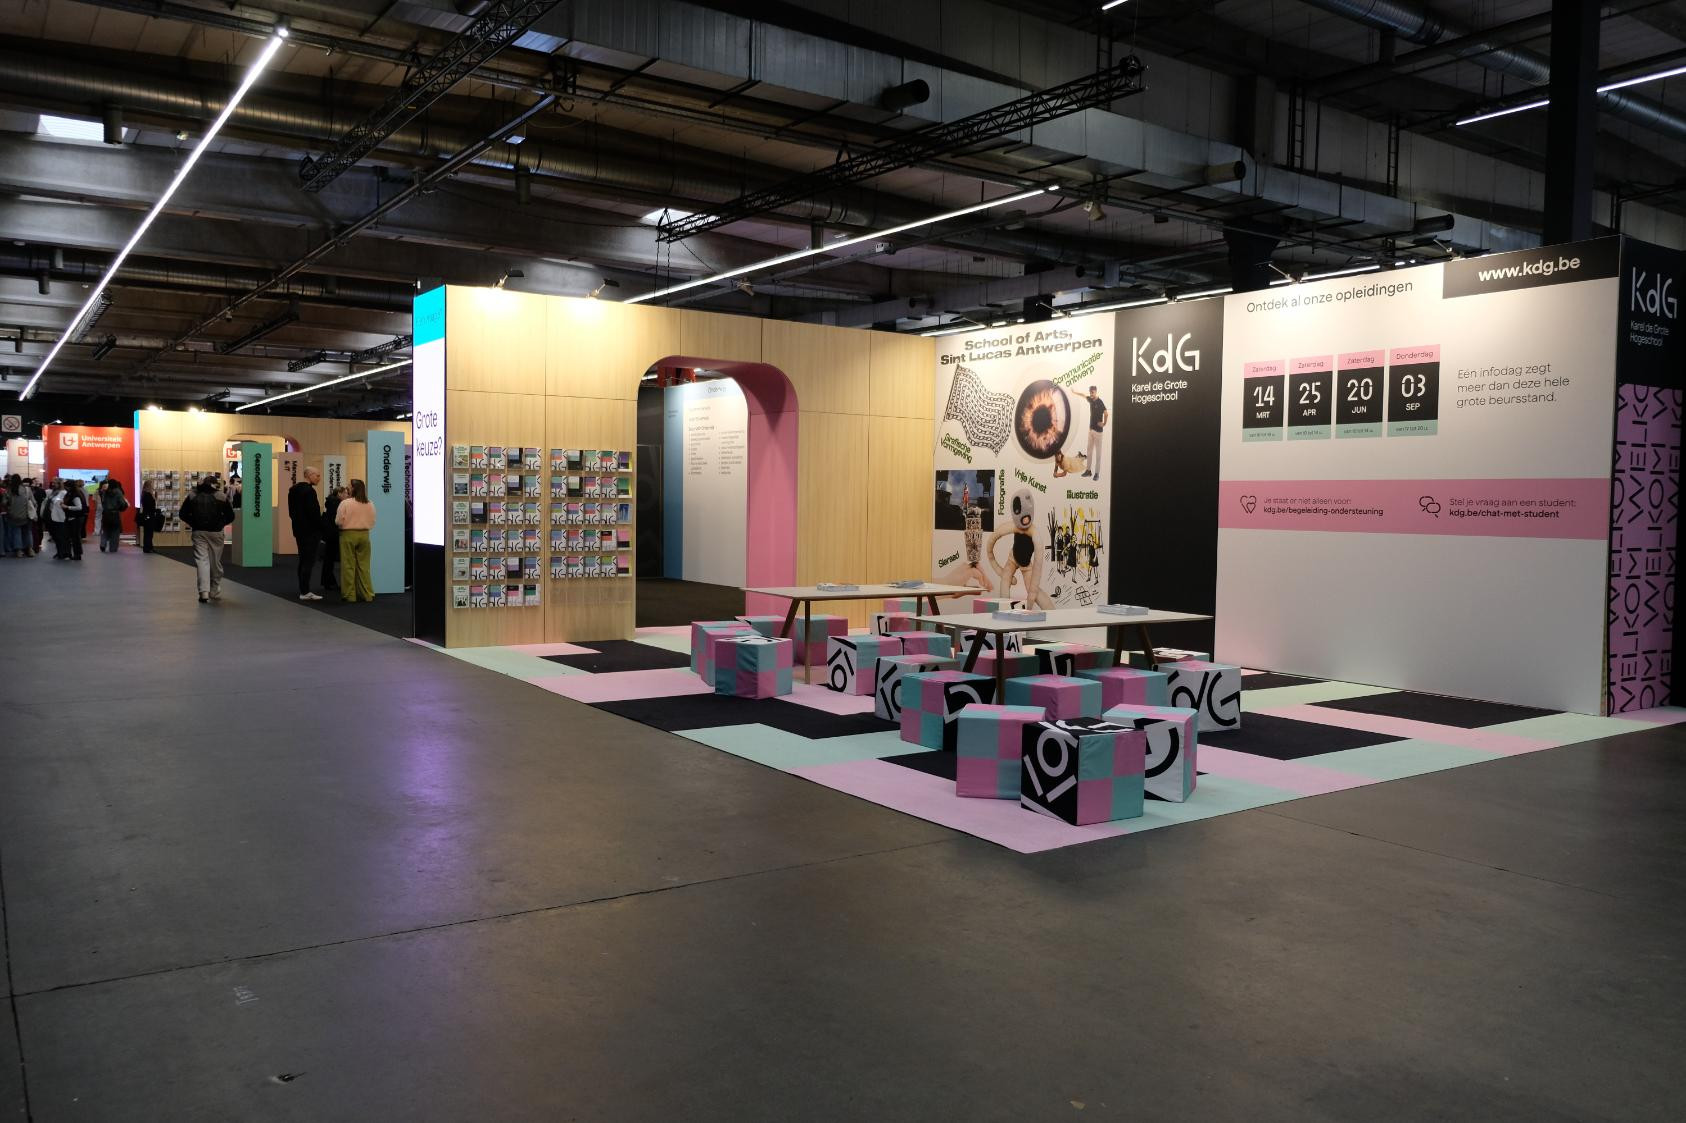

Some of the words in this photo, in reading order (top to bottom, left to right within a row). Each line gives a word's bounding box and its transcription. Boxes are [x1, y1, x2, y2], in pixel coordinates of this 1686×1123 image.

[1478, 257, 1580, 282] www.kdg.be
[1246, 297, 1288, 313] Ontdek
[1291, 296, 1301, 308] al
[1303, 292, 1333, 306] onze
[1336, 282, 1413, 303] opleidingen
[1631, 267, 1677, 319] KdG
[1630, 320, 1645, 332] Karel
[1646, 324, 1653, 333] de
[1654, 325, 1670, 336] Grote
[965, 335, 1012, 351] School
[1016, 332, 1031, 345] of
[1034, 328, 1073, 342] Arts,
[1630, 332, 1663, 347] Hogeschool
[940, 353, 966, 366] Sint
[968, 347, 1012, 362] Lucas
[1016, 338, 1103, 357] Antwerpen
[1132, 332, 1200, 376] KdG
[1396, 352, 1434, 360] Donderdag
[1065, 365, 1095, 388] ontwerp
[1480, 365, 1523, 376] infodag
[1525, 363, 1552, 376] zegt
[1132, 381, 1151, 392] Karel
[1152, 381, 1163, 390] de
[1164, 380, 1188, 390] Grote
[1299, 382, 1321, 404] 25
[1346, 378, 1373, 401] 20
[1401, 374, 1426, 398] 03
[1457, 382, 1486, 393] meer
[1488, 381, 1510, 391] dan
[1512, 379, 1541, 390] deze
[1544, 376, 1570, 387] hele
[1132, 390, 1178, 404] Hogeschool
[1253, 385, 1275, 407] 14
[1456, 397, 1486, 408] grote
[1488, 392, 1557, 405] beursstand.
[1256, 411, 1270, 419] MRT
[1352, 406, 1366, 414] JUN
[1406, 402, 1420, 411] SEP
[416, 411, 438, 429] Grote
[81, 434, 122, 442] Universiteit
[416, 436, 442, 456] keuze?
[382, 444, 392, 494] Onderwijs
[254, 453, 262, 518] Gezondheidszorg
[1014, 468, 1028, 483] Vrije
[1028, 476, 1047, 494] Kunst
[998, 469, 1006, 516] Fotografie
[1067, 490, 1098, 500] Illustratie
[1264, 506, 1384, 516] kdg.be/begeleiding-ondersteuning
[1449, 498, 1465, 506] Stel
[1465, 498, 1474, 508] je
[1475, 500, 1500, 508] vraag
[1538, 498, 1576, 508] student:
[1449, 508, 1560, 518] kdg.be/chat-met-student
[938, 551, 960, 568] Sieraad
